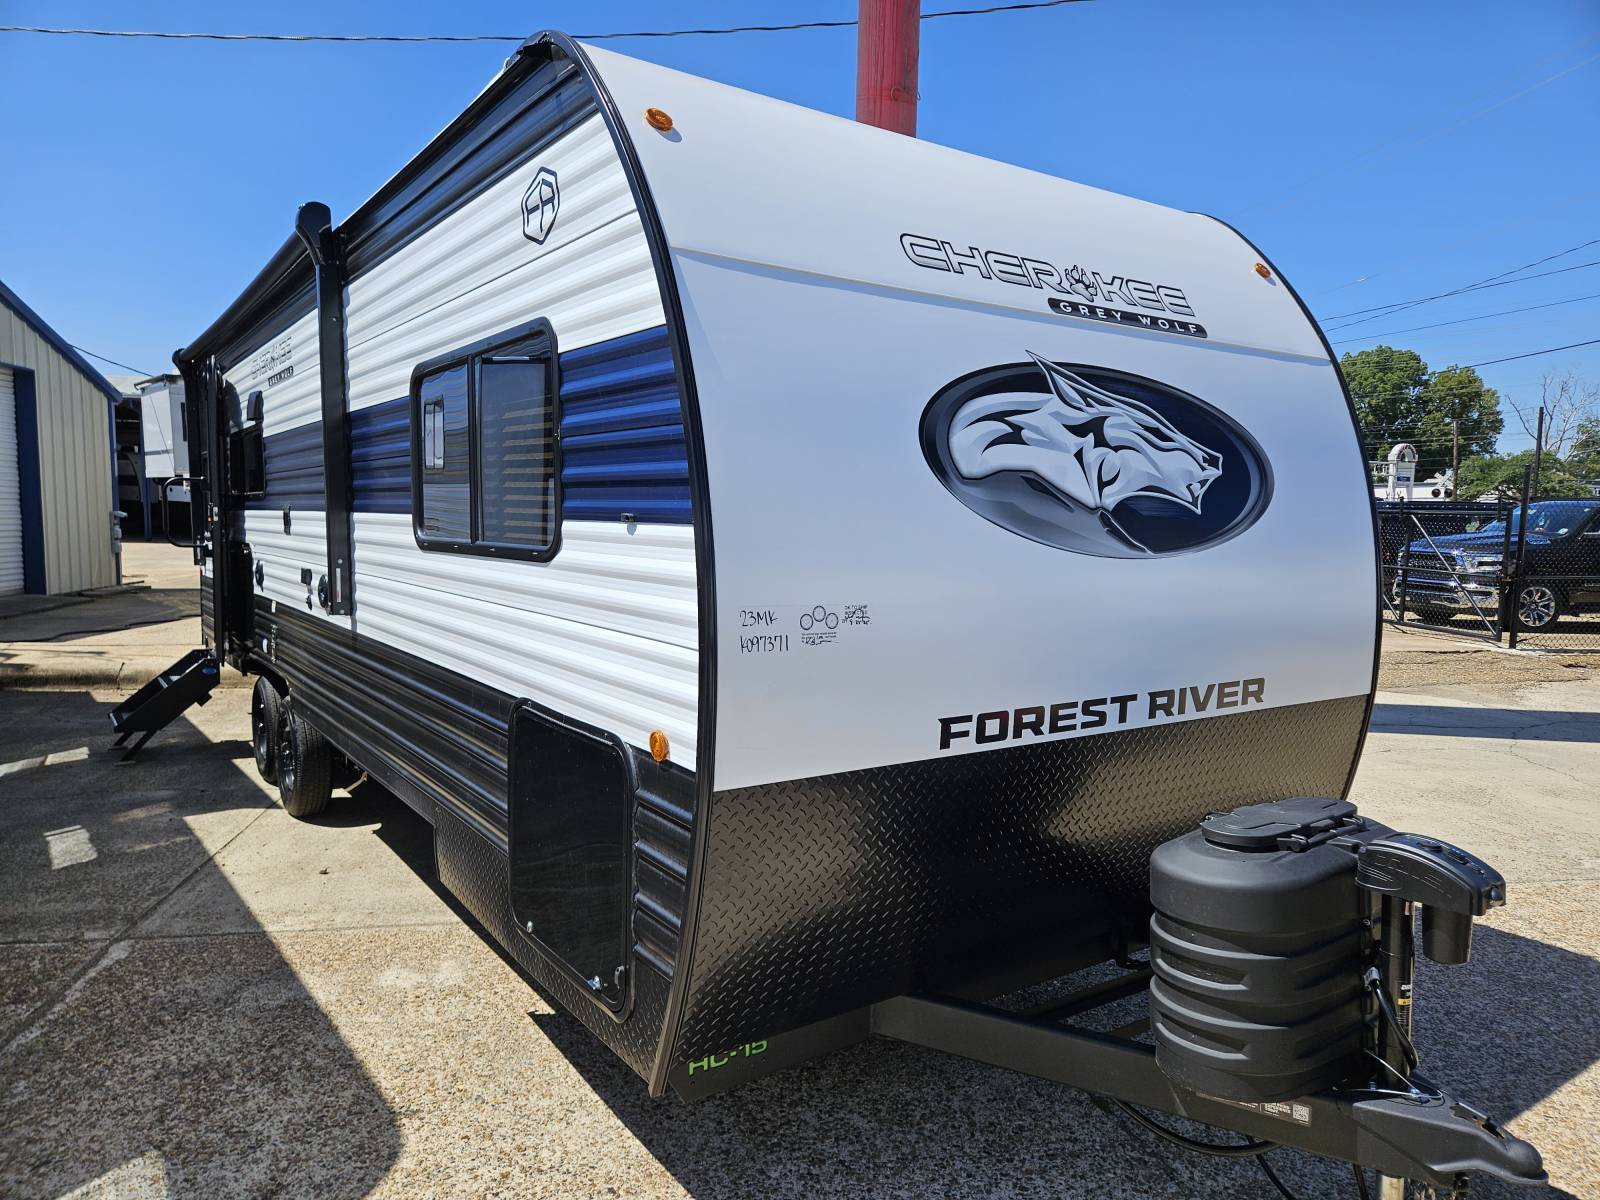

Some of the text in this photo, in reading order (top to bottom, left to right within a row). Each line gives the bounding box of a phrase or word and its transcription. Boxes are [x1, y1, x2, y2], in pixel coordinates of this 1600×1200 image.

[1059, 302, 1198, 334] GREY WOLF
[937, 677, 1265, 750] FOREST RIVER
